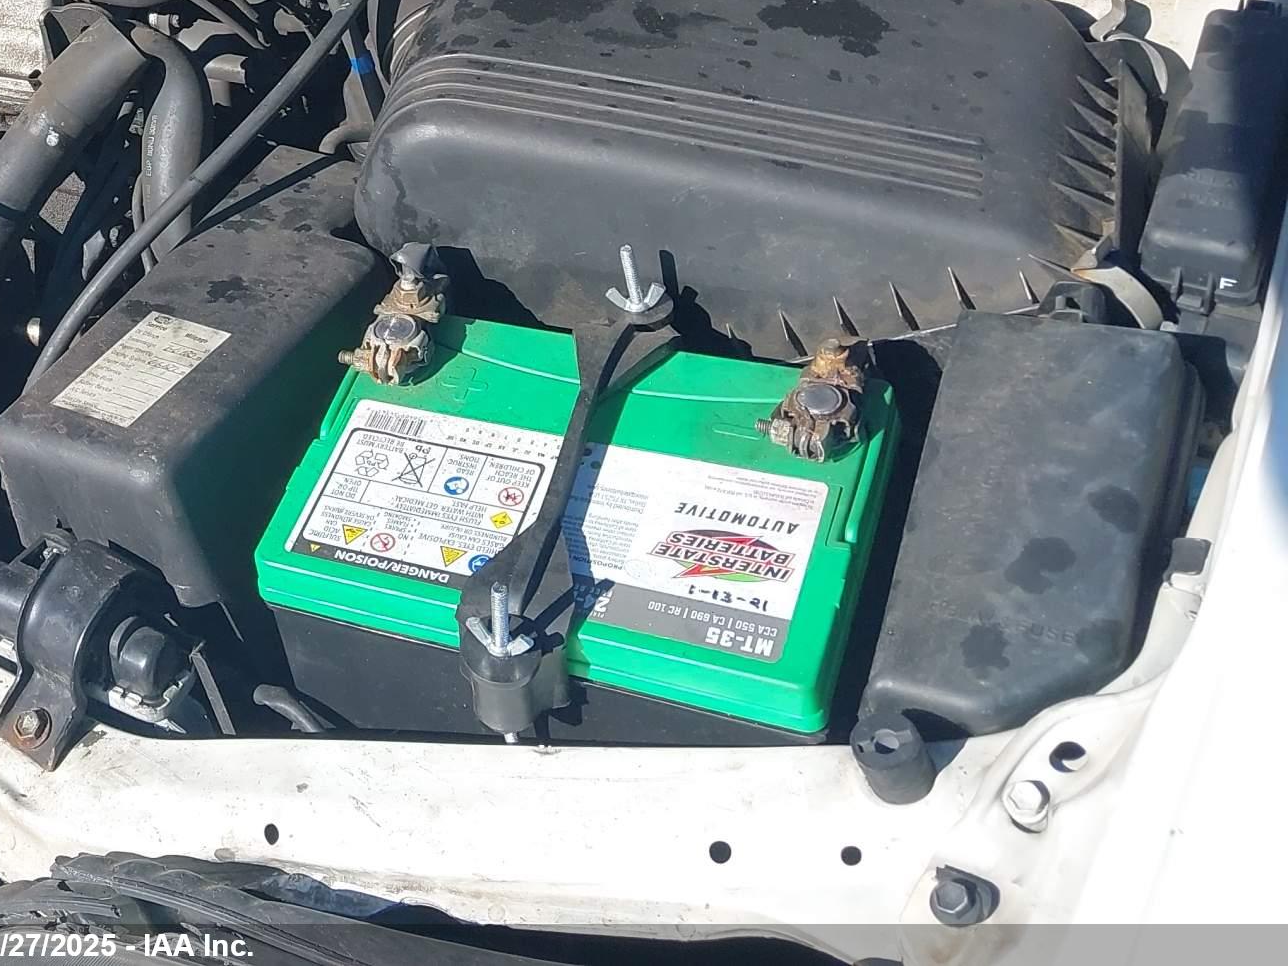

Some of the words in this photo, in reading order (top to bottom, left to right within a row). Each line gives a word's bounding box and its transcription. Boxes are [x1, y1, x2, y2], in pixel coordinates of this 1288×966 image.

[356, 438, 375, 448] MUST
[415, 444, 432, 454] Pb
[494, 469, 518, 480] REACH
[525, 468, 535, 476] OF
[520, 474, 532, 482] THE
[512, 480, 530, 488] KEEP
[426, 501, 439, 510] GET
[470, 504, 488, 513] HELP
[466, 510, 484, 519] WITH
[674, 502, 800, 534] AUTOMOTIVE
[459, 515, 482, 526] FLUSH
[669, 534, 790, 565] BATTERIES
[334, 550, 450, 583] DANGER/POISON
[654, 544, 790, 580] INTERSTATE
[647, 601, 667, 613] 100
[668, 605, 682, 616] RC
[691, 610, 711, 622] 690
[712, 614, 726, 625] CA
[736, 620, 756, 632] 550
[758, 624, 778, 636] CCA
[705, 626, 775, 657] MT-35
